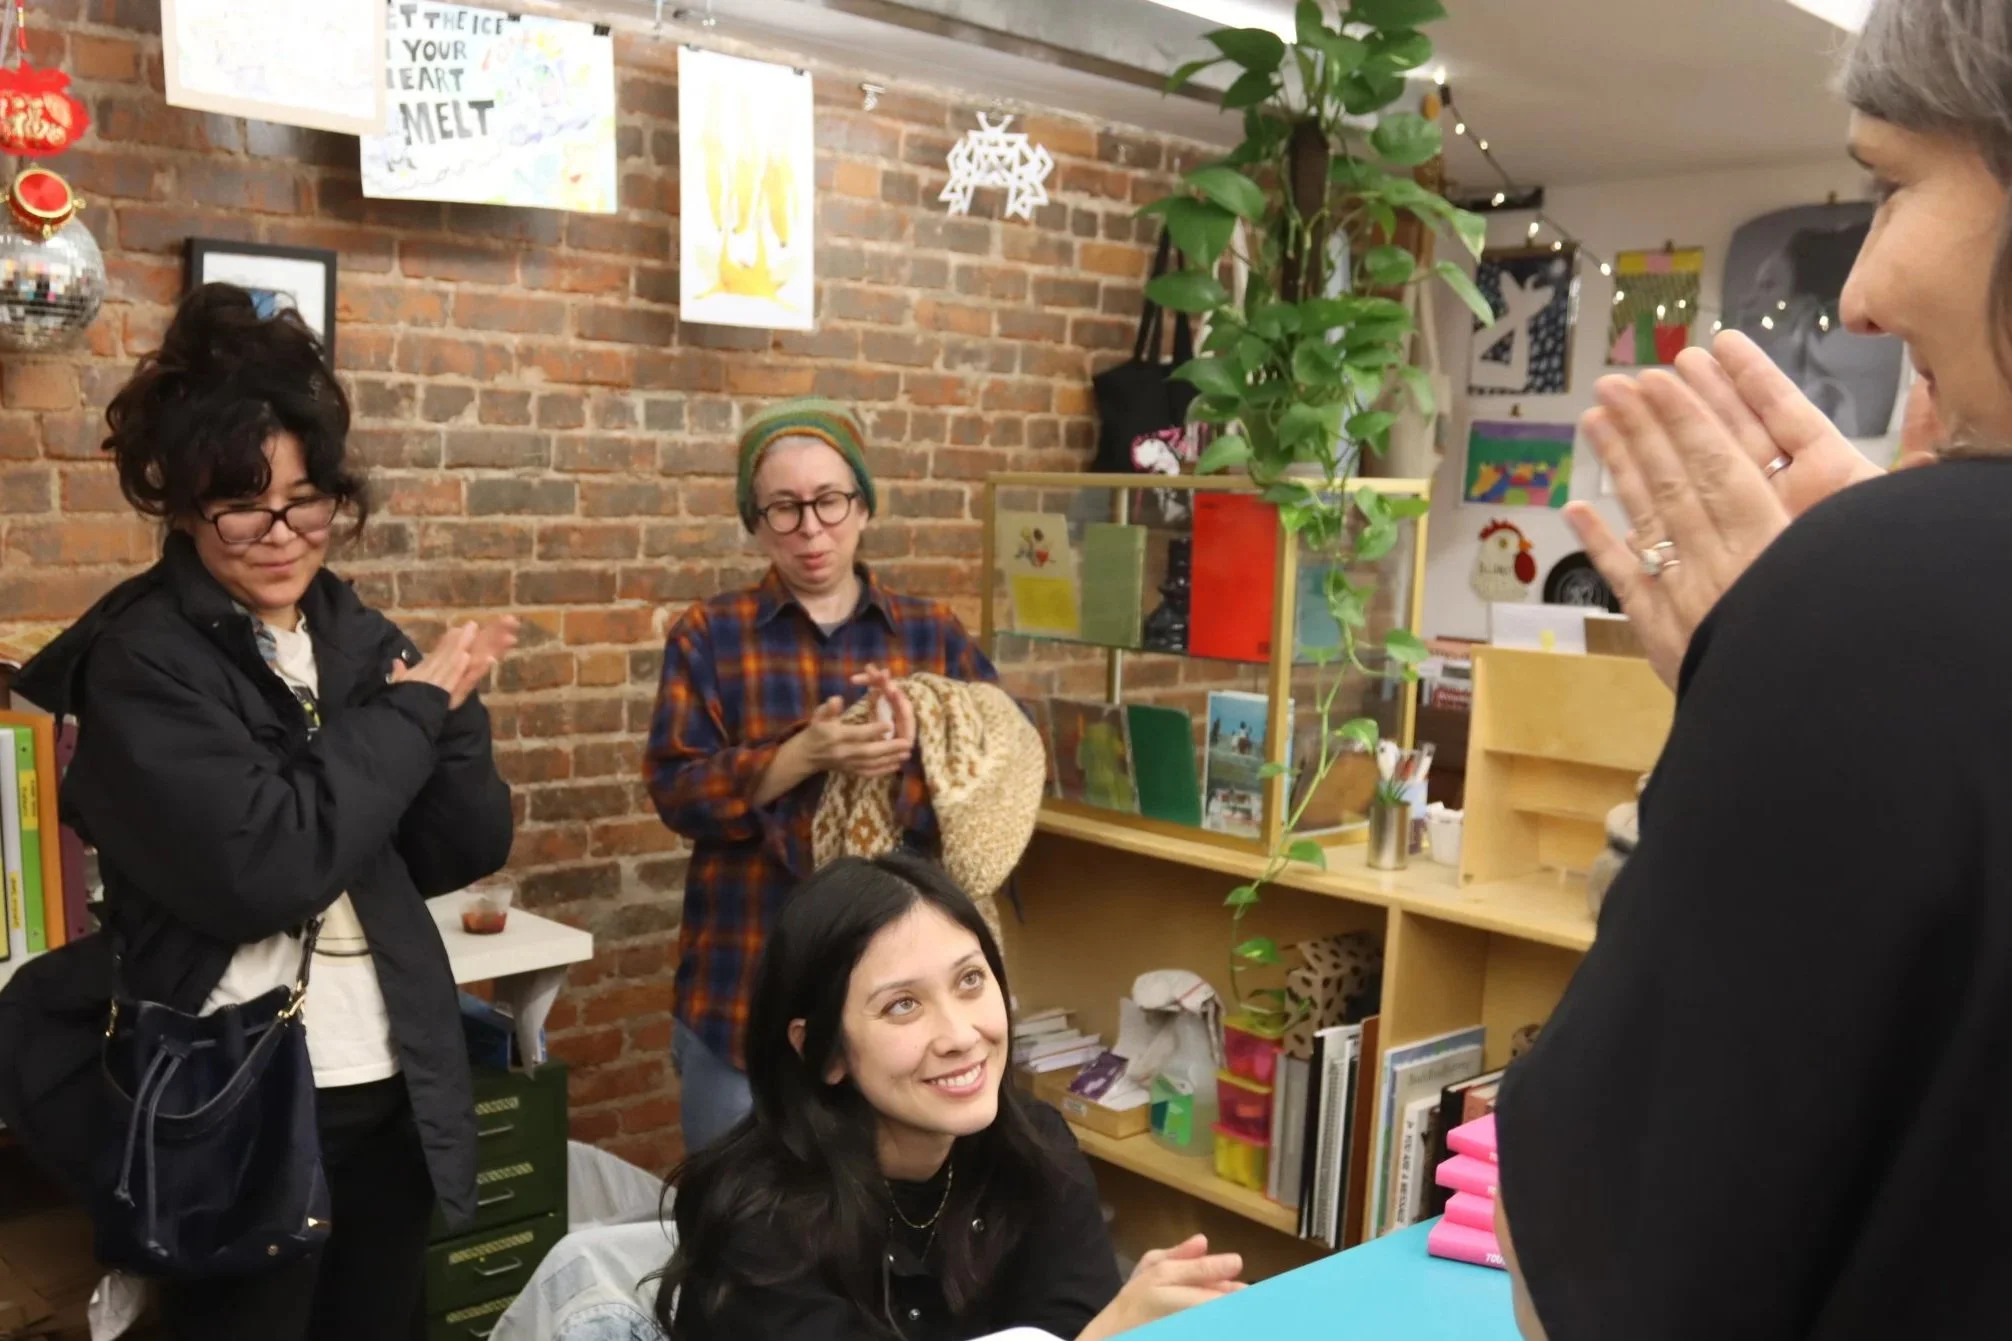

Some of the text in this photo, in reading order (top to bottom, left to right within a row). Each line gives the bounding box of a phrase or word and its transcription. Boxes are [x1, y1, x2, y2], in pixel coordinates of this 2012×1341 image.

[386, 4, 504, 35] ET THE ICE
[402, 39, 468, 62] YOUR
[399, 100, 494, 145] MELT
